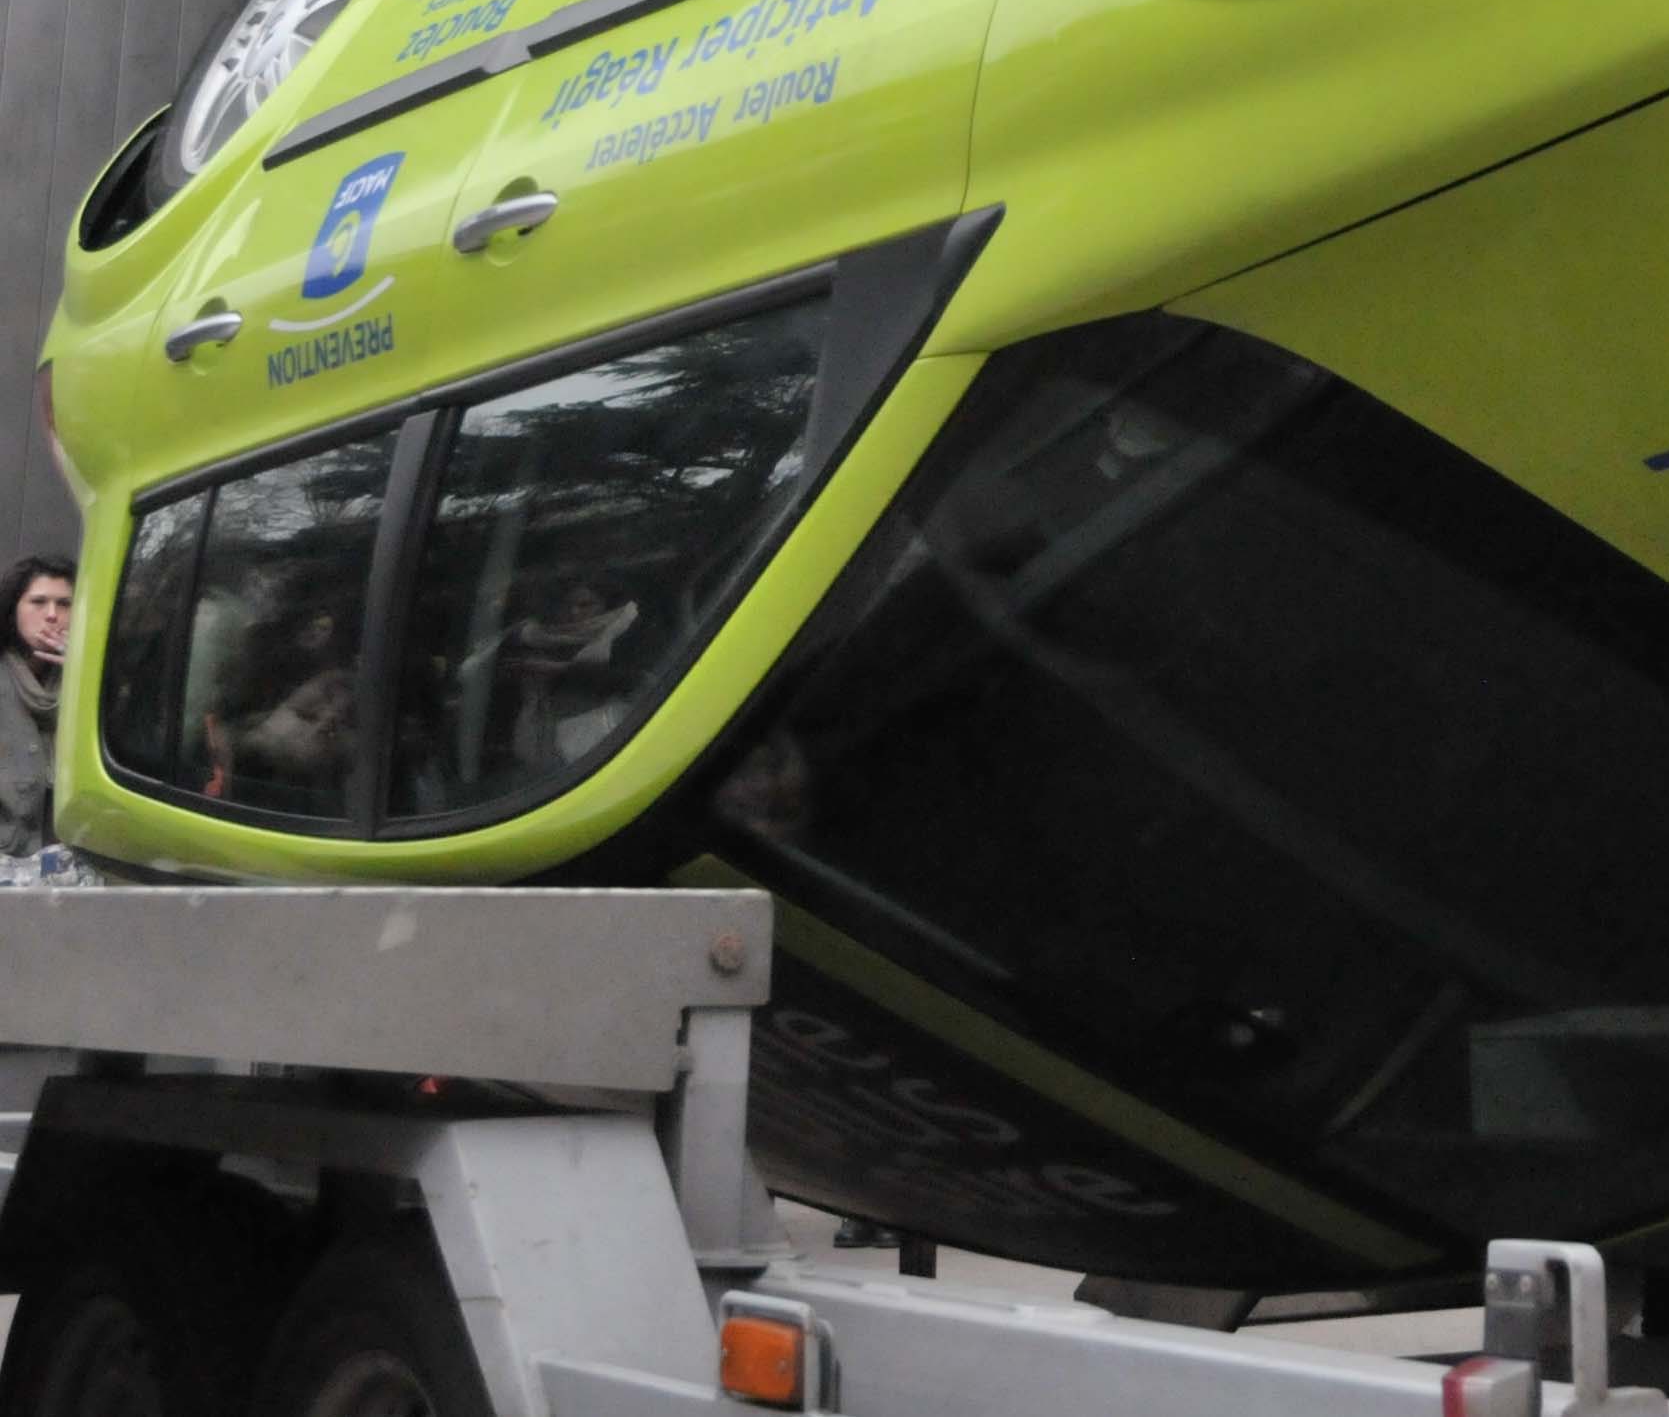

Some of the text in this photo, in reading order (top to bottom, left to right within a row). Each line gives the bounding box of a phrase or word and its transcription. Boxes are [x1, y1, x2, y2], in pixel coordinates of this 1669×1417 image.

[541, 37, 680, 129] Réagir
[733, 55, 841, 124] Rouler
[333, 165, 395, 210] MACIF
[268, 311, 395, 390] PREVENTION
